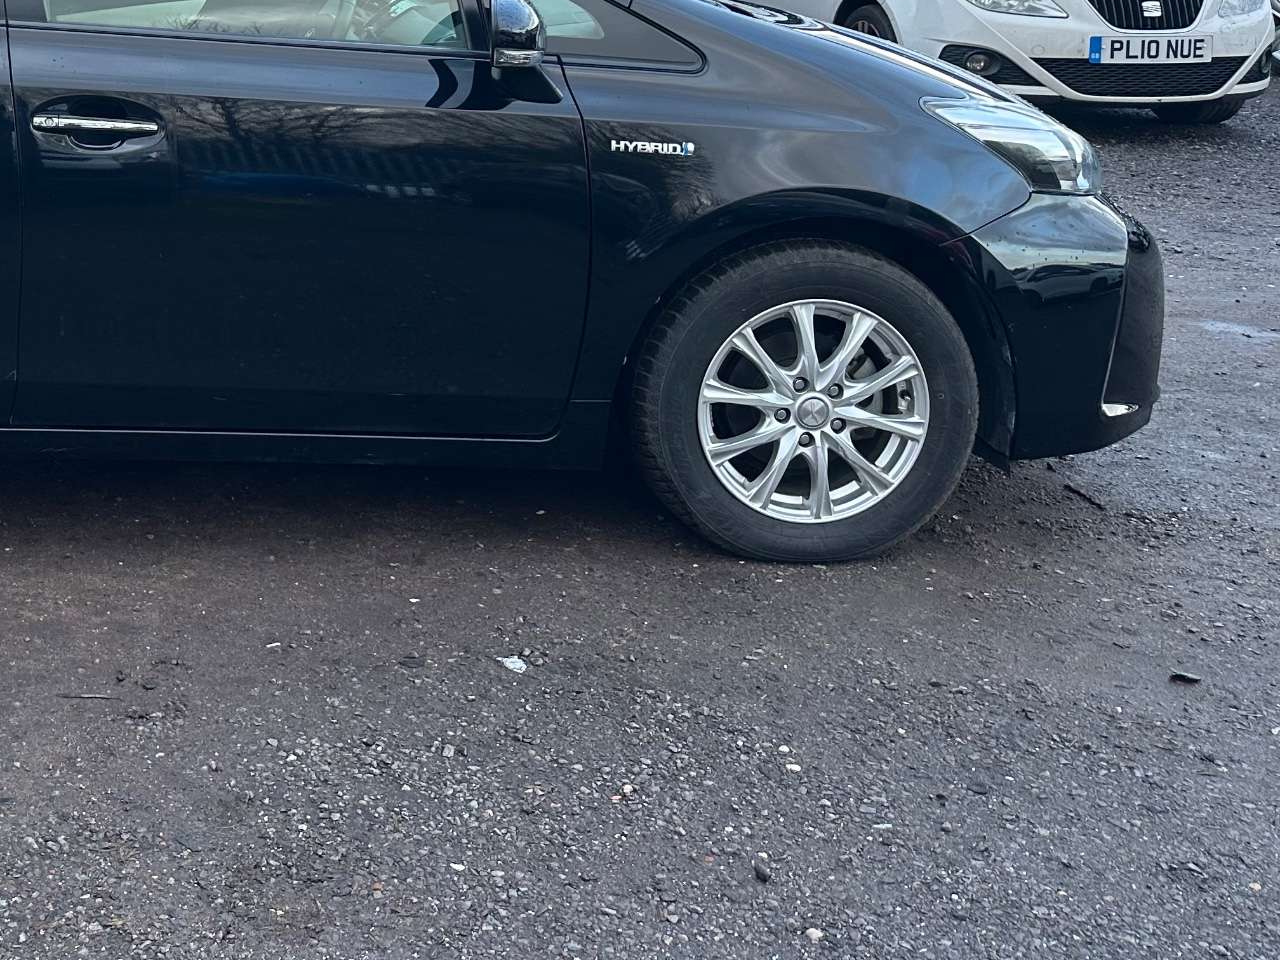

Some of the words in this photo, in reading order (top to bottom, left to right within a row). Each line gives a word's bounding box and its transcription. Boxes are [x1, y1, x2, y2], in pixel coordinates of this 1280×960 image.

[1110, 39, 1160, 59] PL10
[1166, 39, 1205, 59] NUE
[611, 140, 681, 155] HYBRID
